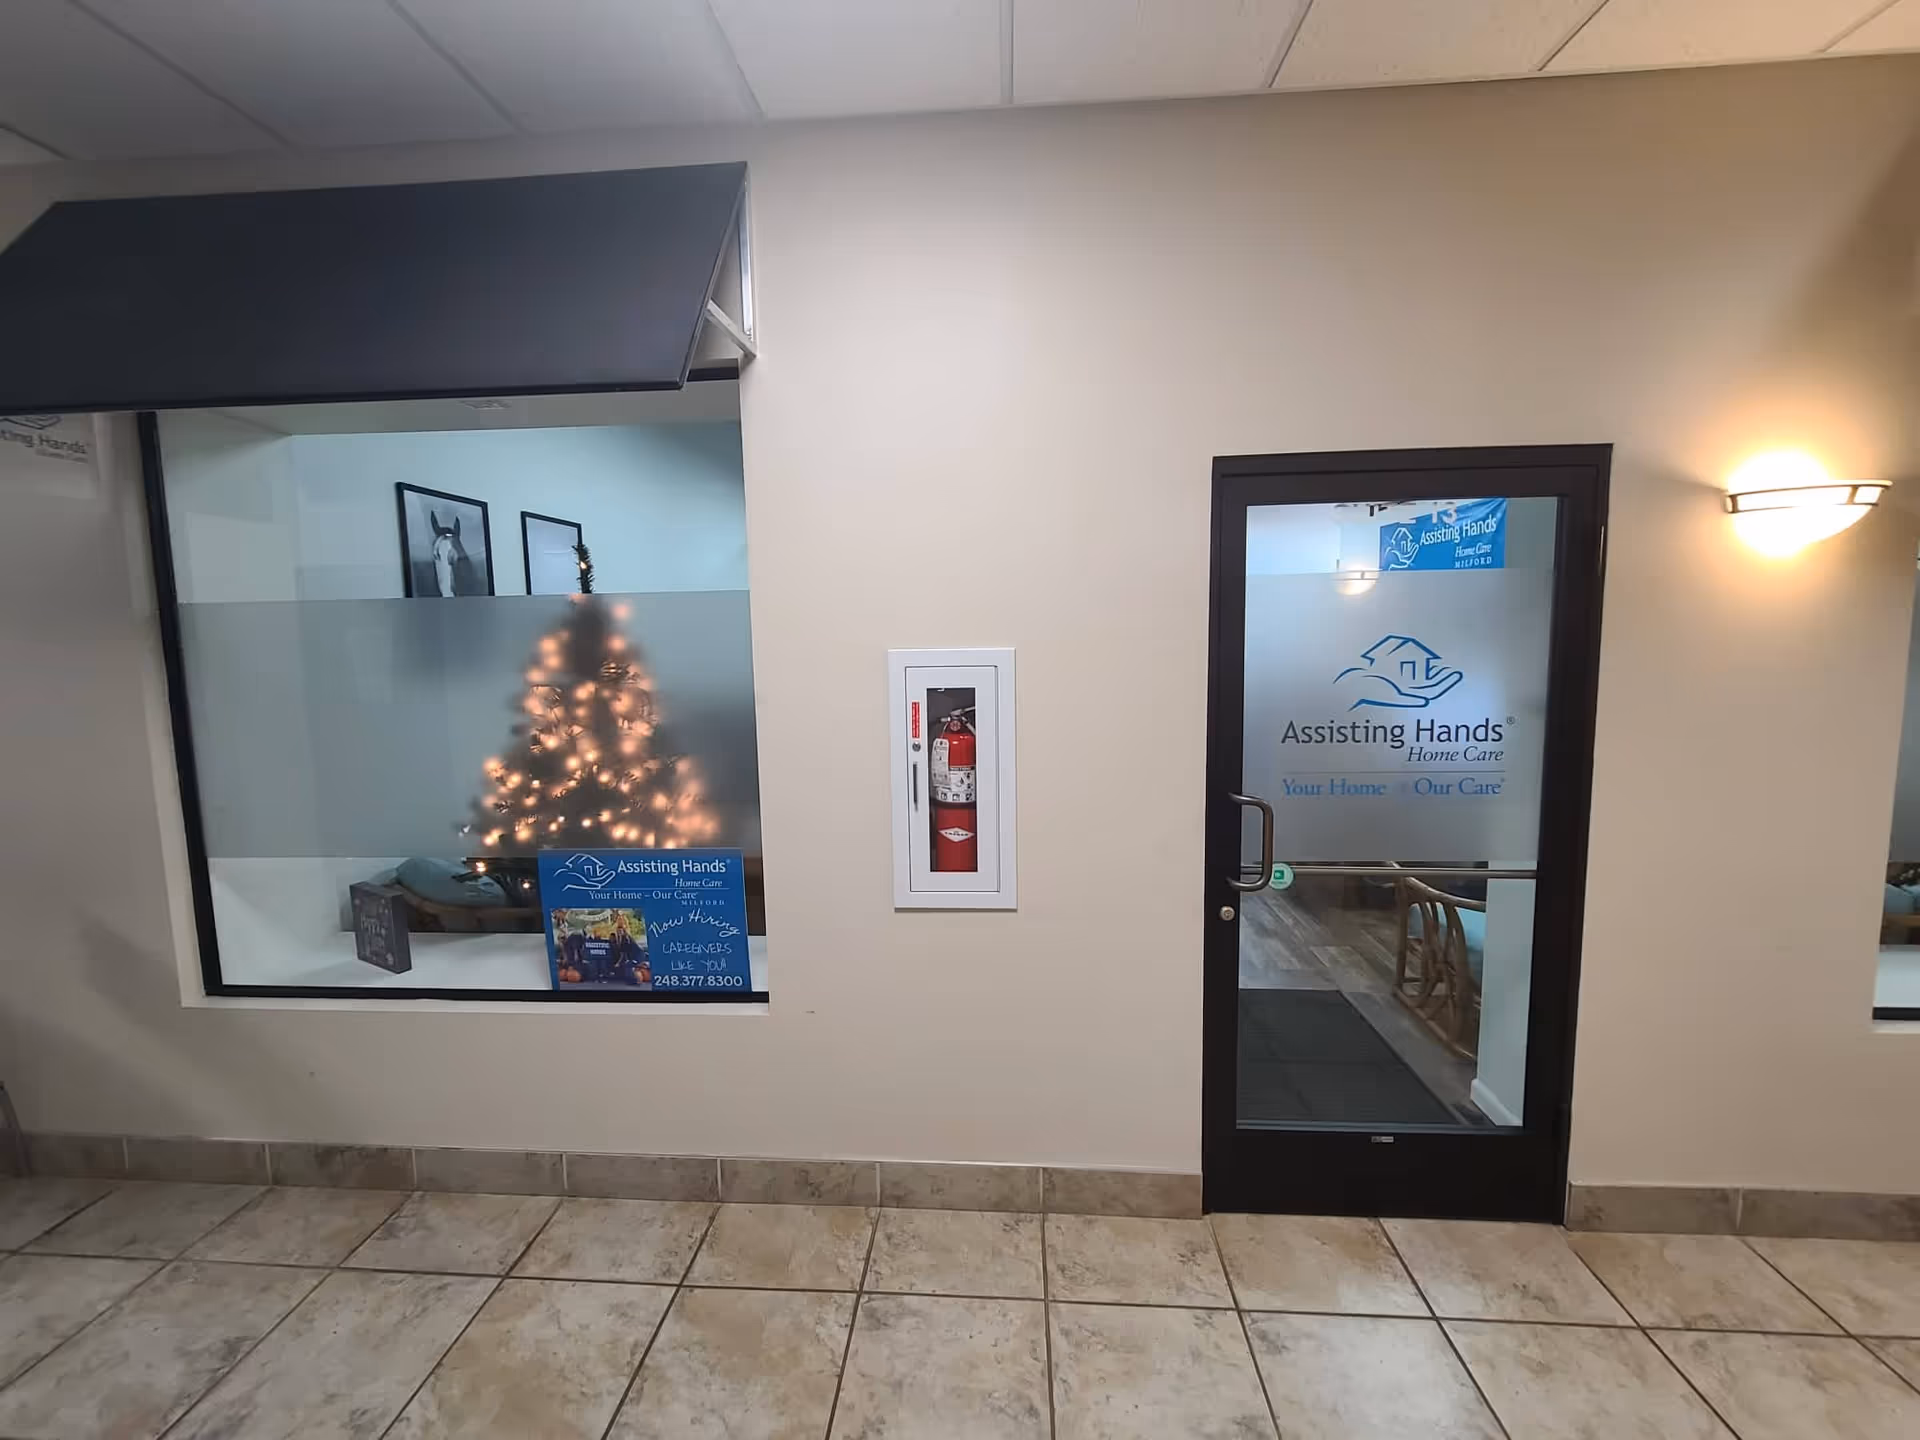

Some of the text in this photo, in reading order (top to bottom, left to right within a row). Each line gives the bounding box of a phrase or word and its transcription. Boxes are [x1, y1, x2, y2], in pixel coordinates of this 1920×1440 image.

[1420, 514, 1497, 546] Assisting Hands
[1455, 543, 1492, 557] Home Care
[1454, 557, 1492, 569] MILFORD
[1281, 719, 1405, 749] Assisting
[1408, 745, 1504, 762] Home Care
[1282, 777, 1502, 796] Your Home Our Care
[617, 859, 727, 876] Assisting Hands
[675, 877, 723, 888] Home Care
[588, 890, 611, 900] Your
[613, 890, 642, 900] Home
[652, 890, 673, 900] Our
[674, 890, 698, 900] Care
[648, 907, 740, 938] Now Hiring
[662, 941, 733, 955] CAREGIVERS
[671, 960, 695, 972] LIKE
[654, 975, 744, 987] 248.377.8300
